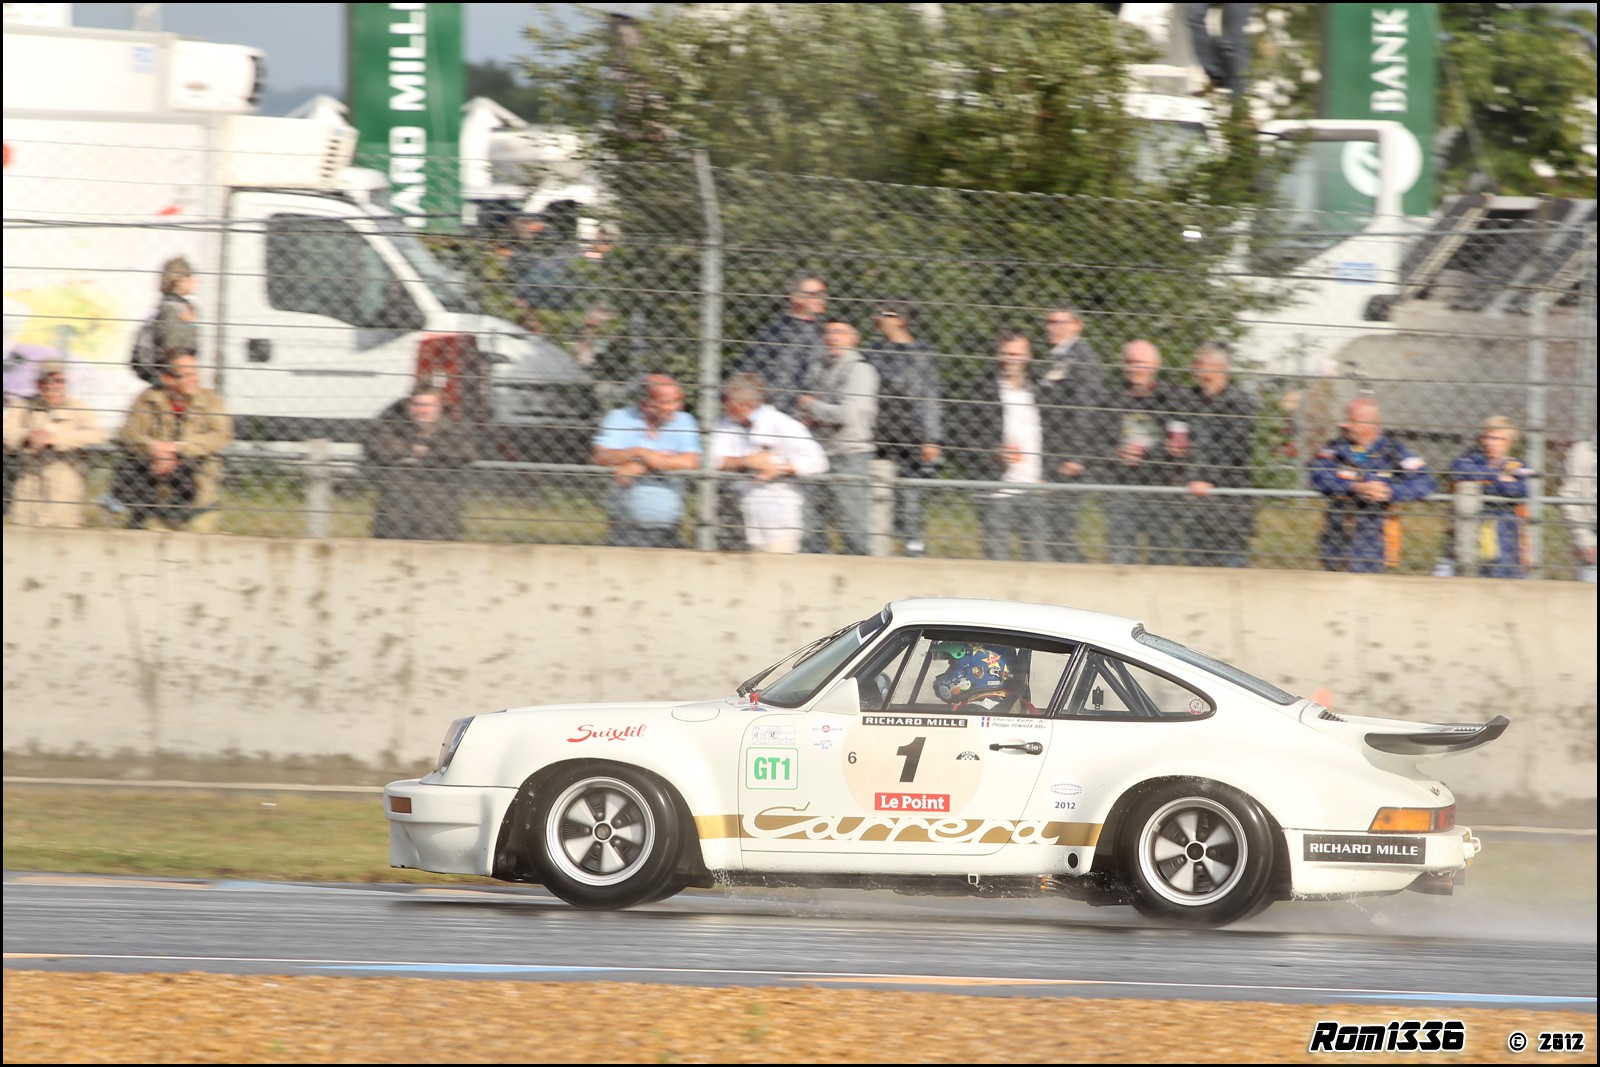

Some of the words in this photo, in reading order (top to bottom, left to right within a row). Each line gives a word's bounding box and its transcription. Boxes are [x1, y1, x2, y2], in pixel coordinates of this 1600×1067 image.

[1370, 8, 1409, 112] BANK
[865, 717, 922, 727] RICHARD
[926, 718, 966, 728] MILLE
[566, 723, 647, 743] Suixtil
[847, 751, 858, 765] 6
[896, 736, 927, 783] 1
[753, 756, 791, 781] GT1
[880, 795, 899, 809] Le
[901, 795, 945, 810] Point
[1054, 801, 1076, 810] 2012
[741, 801, 1060, 846] Carrera
[1309, 843, 1372, 854] RICHARD
[1376, 845, 1419, 856] MILLE
